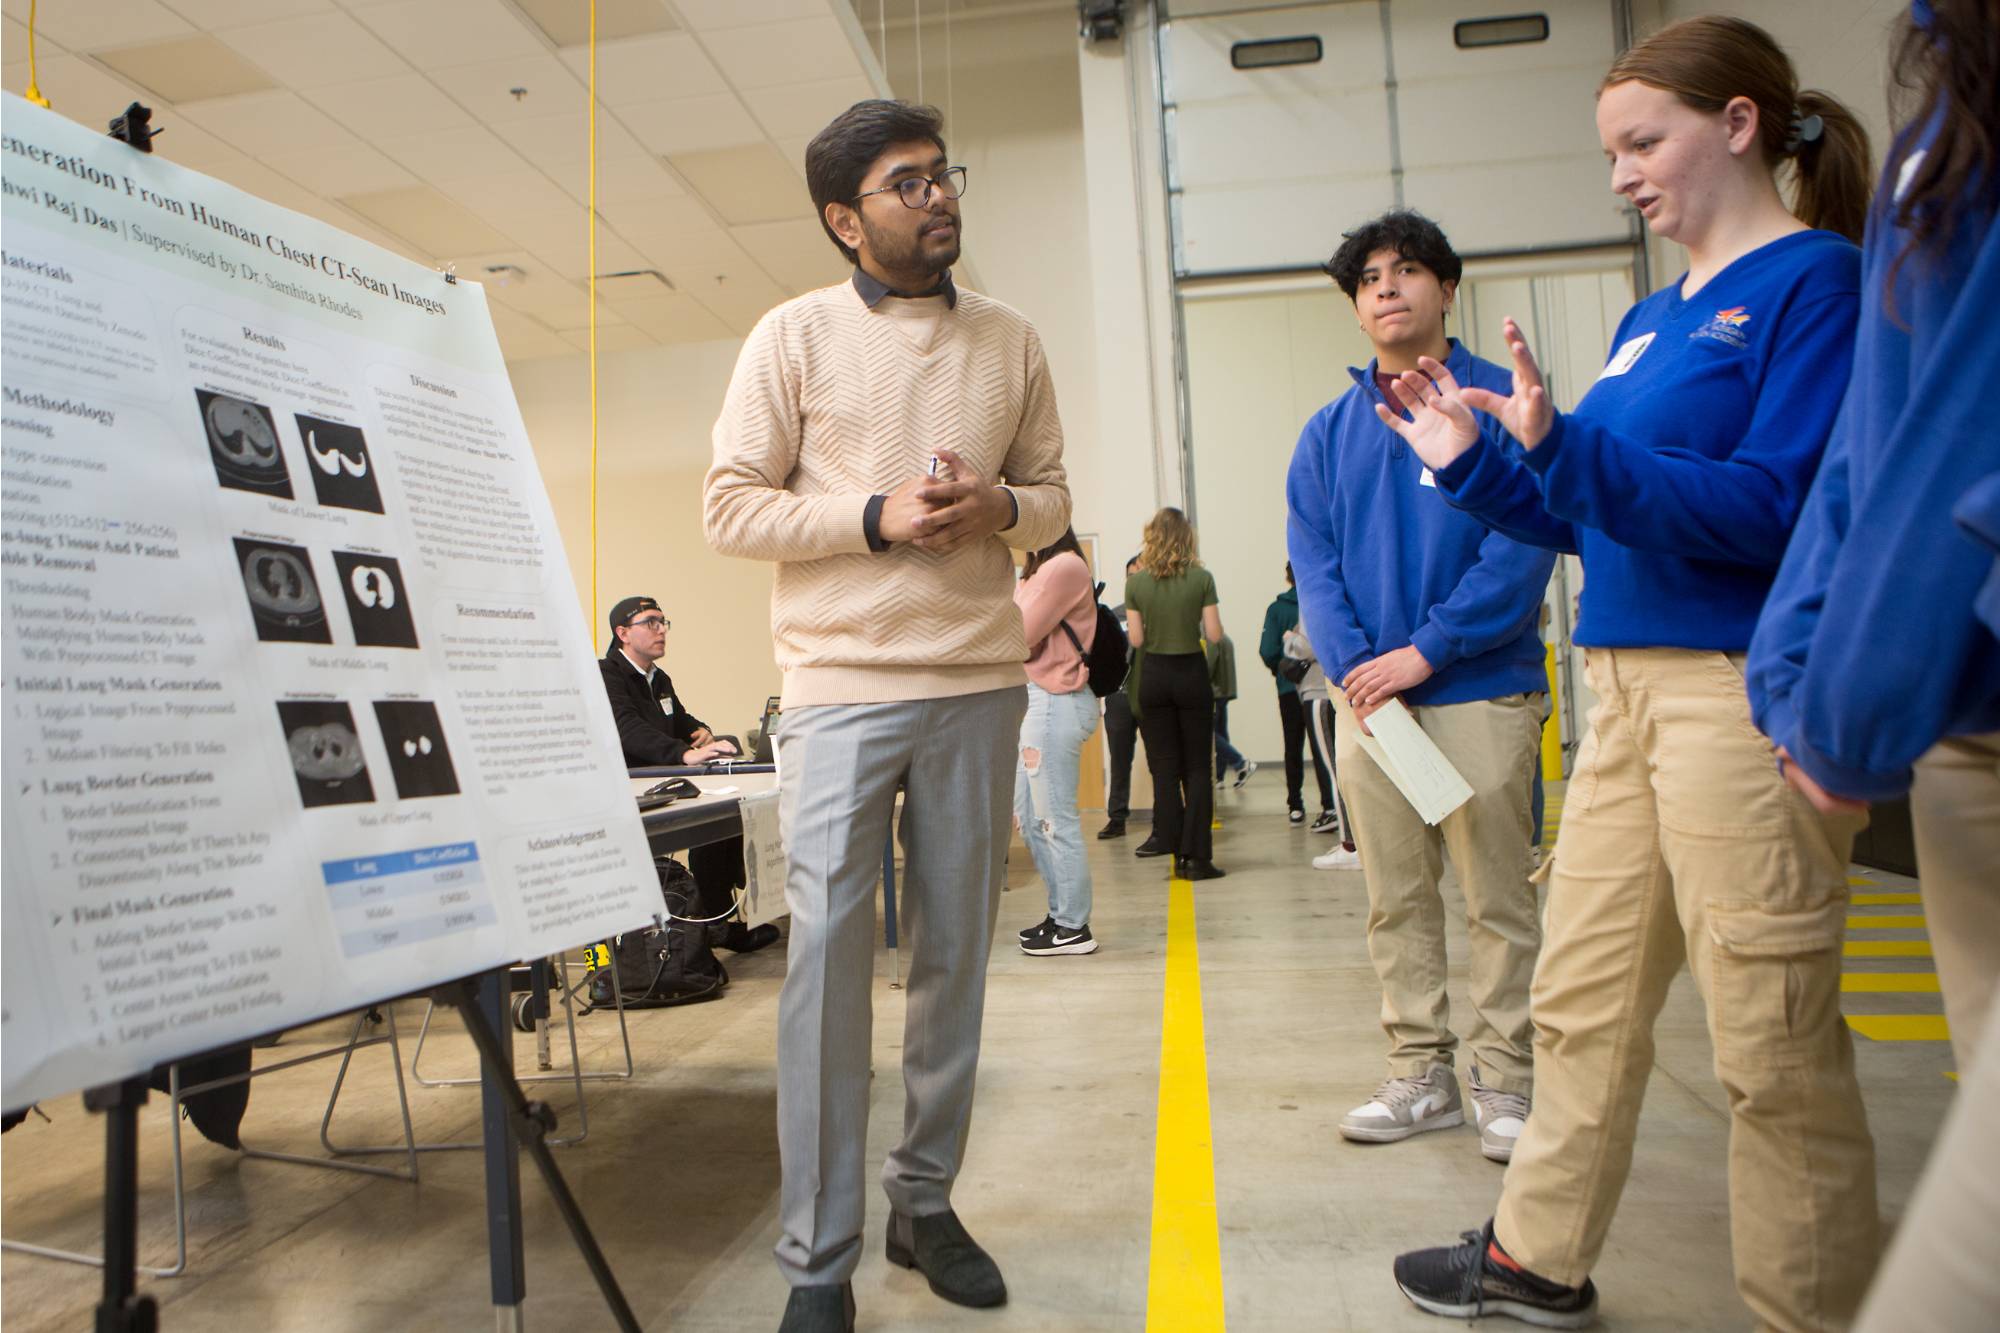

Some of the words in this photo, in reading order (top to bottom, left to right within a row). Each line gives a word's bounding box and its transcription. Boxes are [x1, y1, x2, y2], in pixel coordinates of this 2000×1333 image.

[44, 192, 79, 223] Raj
[83, 207, 118, 234] Das
[131, 223, 217, 268] Supervised
[219, 255, 238, 279] by
[241, 263, 263, 285] Dr.
[265, 272, 316, 305] Samhita
[318, 292, 364, 321] Rhodes
[123, 175, 185, 216] From
[190, 201, 261, 248] Human
[266, 234, 317, 270] Chest
[321, 255, 389, 297] CT-Scan
[392, 283, 447, 316] Images
[242, 326, 286, 350] Results
[410, 374, 458, 399] Discussion
[2, 386, 115, 427] Methodology
[104, 540, 132, 554] And
[33, 552, 96, 572] Removal
[456, 603, 536, 620] Recommendation
[15, 677, 63, 692] Initial
[66, 677, 107, 694] Lung
[109, 677, 147, 691] Mask
[151, 677, 223, 691] Generation
[41, 779, 84, 795] Lung
[86, 775, 138, 791] Border
[141, 771, 214, 788] Generation
[62, 805, 107, 821] Border
[72, 903, 112, 925] Final
[116, 898, 155, 914] Mask
[158, 886, 235, 908] Generation
